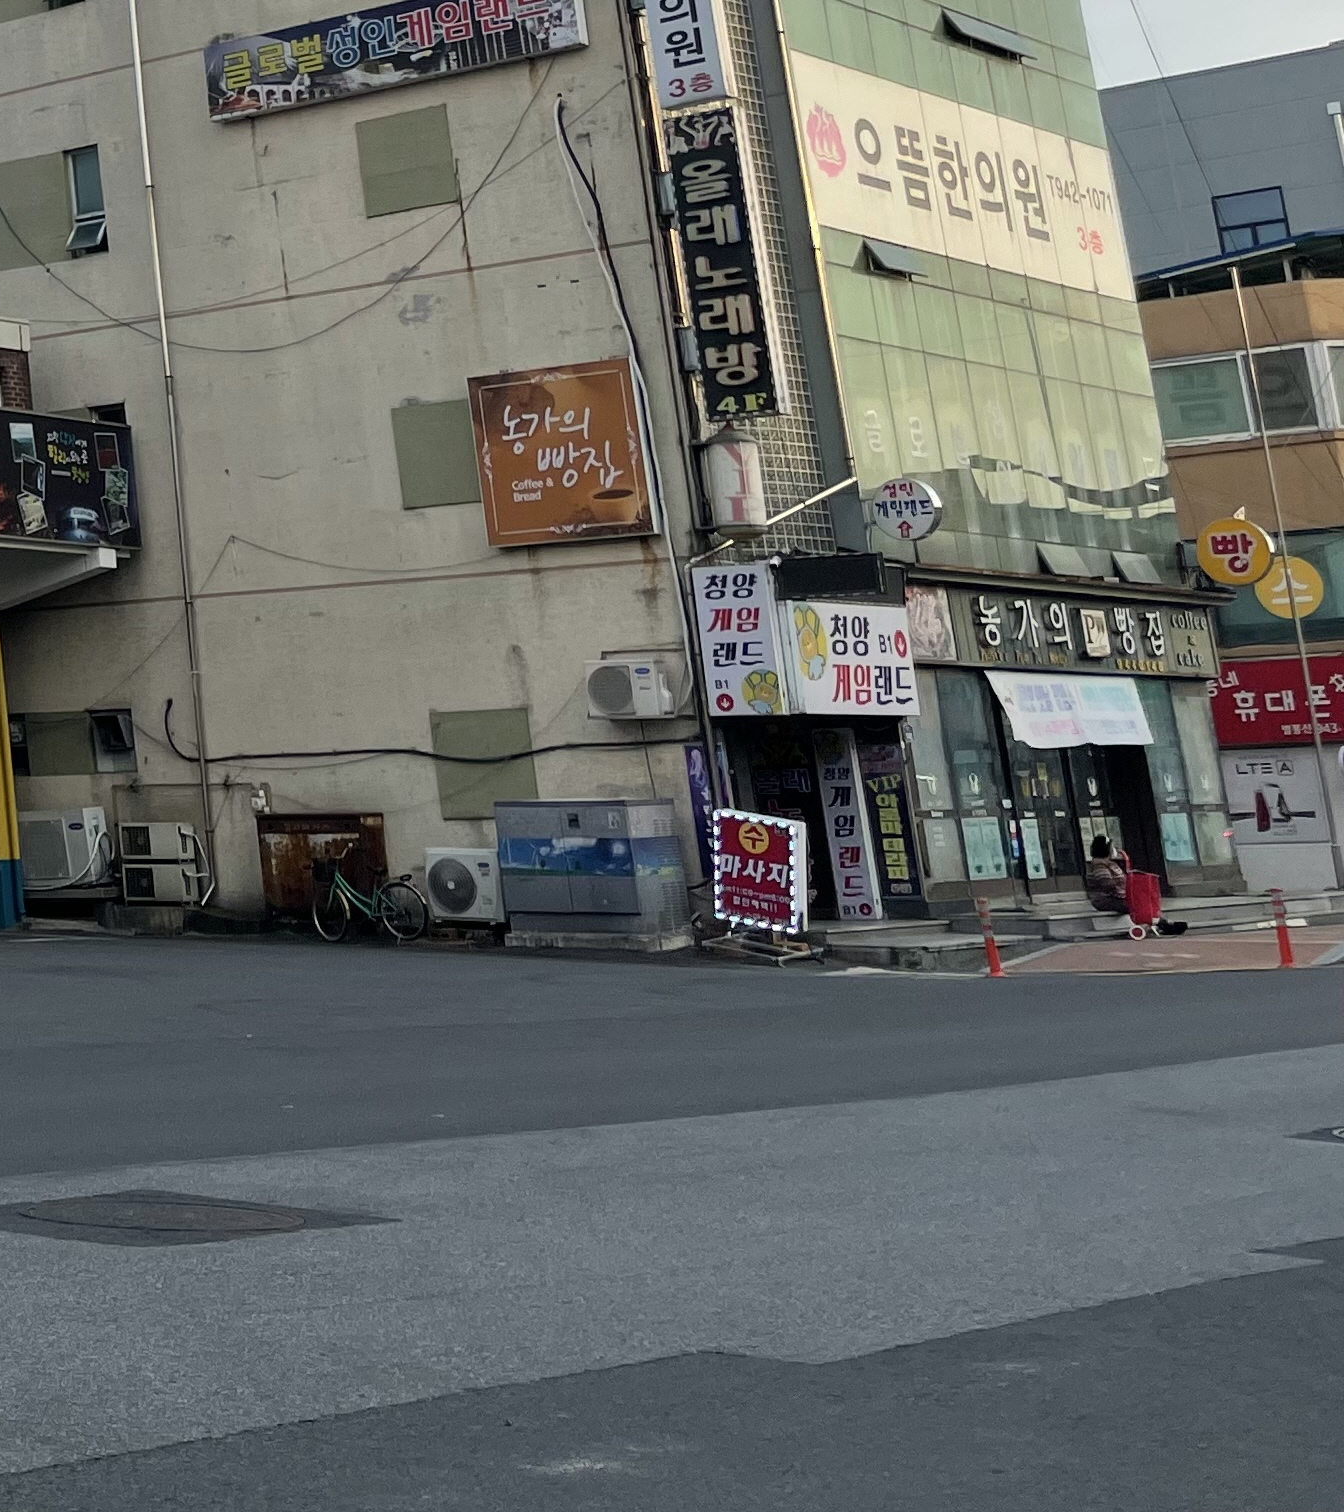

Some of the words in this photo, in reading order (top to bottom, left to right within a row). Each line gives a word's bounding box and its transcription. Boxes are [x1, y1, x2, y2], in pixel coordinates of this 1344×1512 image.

[669, 73, 714, 99] 3층
[854, 118, 1051, 243] 으뜸한의원
[1077, 226, 1104, 255] 3층
[717, 394, 769, 415] 4F
[502, 405, 591, 455] 농가의
[537, 440, 624, 488] 빵집
[512, 478, 544, 491] Coffee
[513, 491, 542, 503] Bread
[1211, 533, 1254, 574] 빵
[704, 573, 759, 601] 청양
[707, 606, 762, 634] 게임
[979, 595, 1073, 650] 농가의
[1113, 607, 1166, 658] 빵집
[830, 614, 870, 657] 청양
[879, 633, 894, 655] B1
[712, 641, 765, 669] 랜드
[832, 661, 914, 707] 게임랜드
[823, 765, 851, 783] 청양
[743, 825, 765, 850] 수
[719, 853, 790, 889] 마사지
